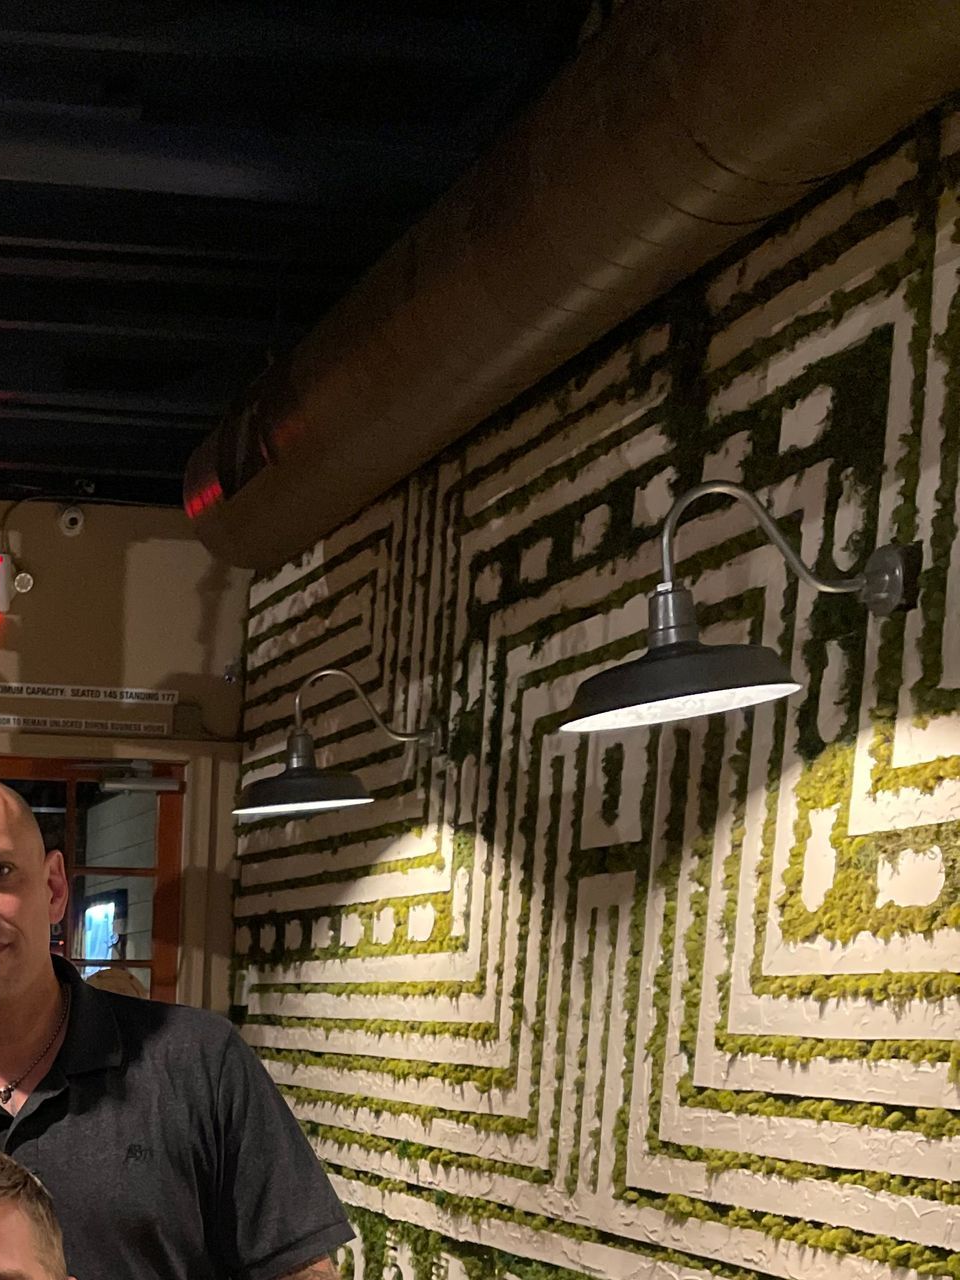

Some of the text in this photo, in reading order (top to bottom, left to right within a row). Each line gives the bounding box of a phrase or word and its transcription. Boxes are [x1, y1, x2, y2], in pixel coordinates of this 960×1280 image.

[70, 688, 101, 699] SEATED
[103, 690, 118, 700] 145
[120, 690, 159, 702] STANDING
[161, 693, 176, 702] 177
